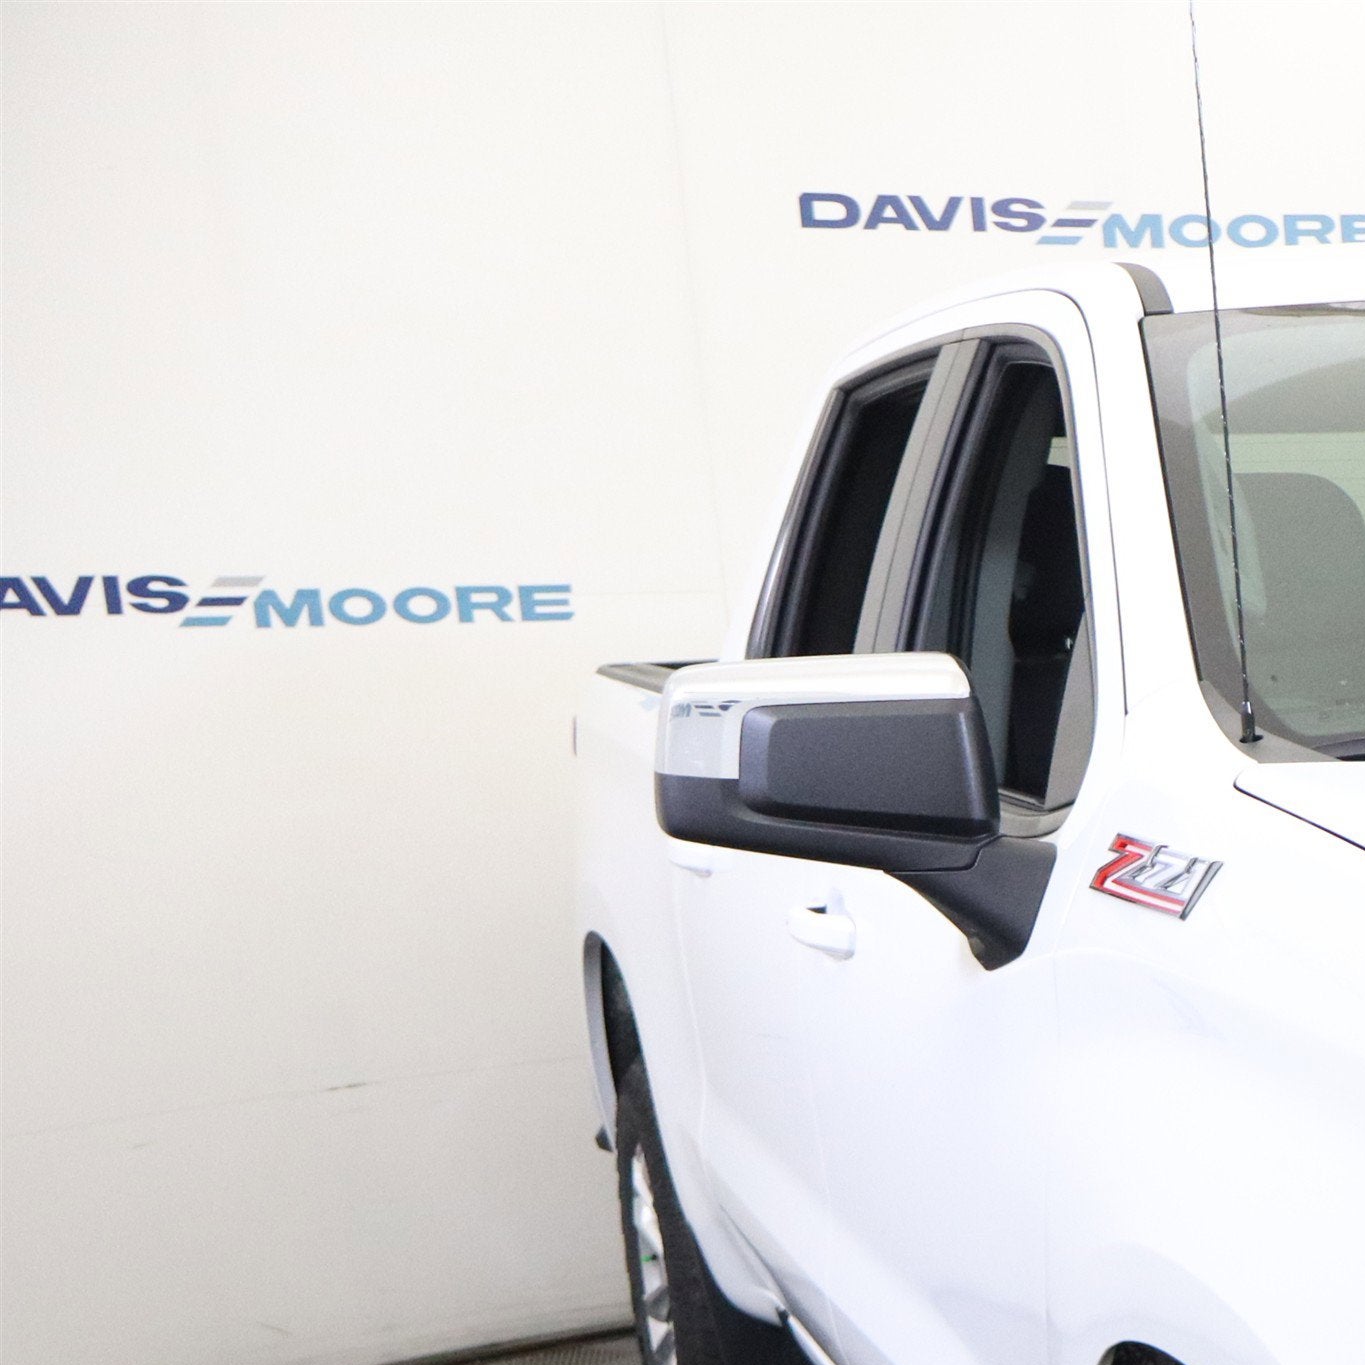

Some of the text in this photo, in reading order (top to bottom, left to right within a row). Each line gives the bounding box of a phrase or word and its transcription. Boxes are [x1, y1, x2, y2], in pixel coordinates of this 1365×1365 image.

[799, 191, 1047, 232] DAVIS
[0, 572, 577, 629] AVIS MOORE
